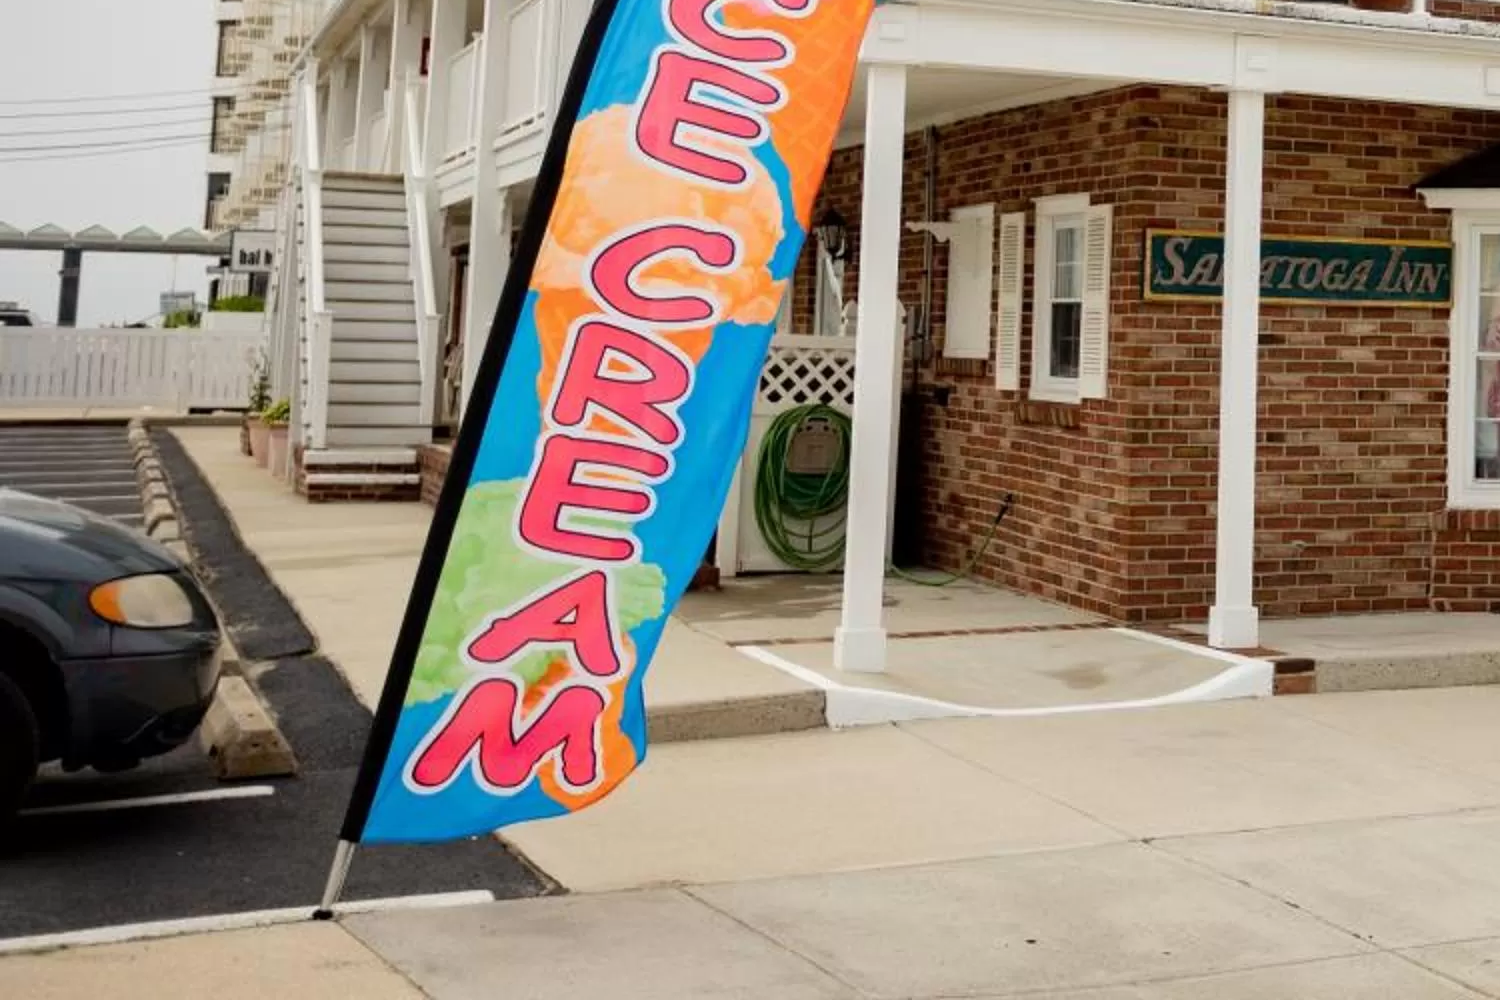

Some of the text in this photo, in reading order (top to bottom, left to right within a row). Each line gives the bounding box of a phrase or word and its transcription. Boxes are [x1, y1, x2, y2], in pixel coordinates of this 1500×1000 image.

[1153, 236, 1448, 294] SAATOGA INN
[409, 221, 739, 791] CREAM
